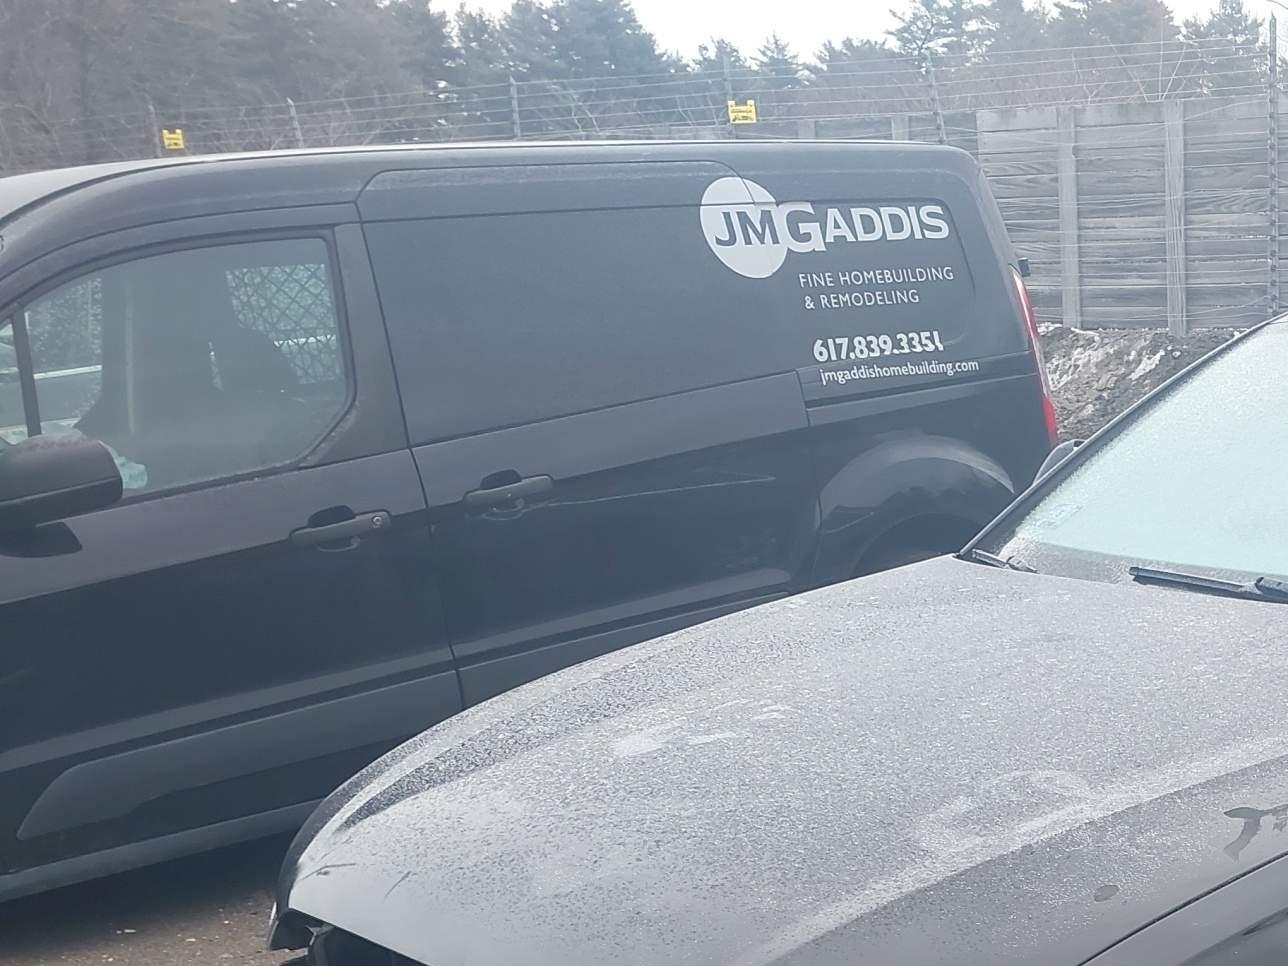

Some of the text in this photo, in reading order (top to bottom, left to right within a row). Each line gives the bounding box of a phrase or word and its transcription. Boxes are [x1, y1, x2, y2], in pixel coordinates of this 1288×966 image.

[799, 266, 954, 288] FINE HOMEBUILDING
[804, 289, 920, 310] & REMODELING
[813, 331, 944, 362] 617.839.3351
[820, 360, 980, 385] jmgaddishomebuilding.com
